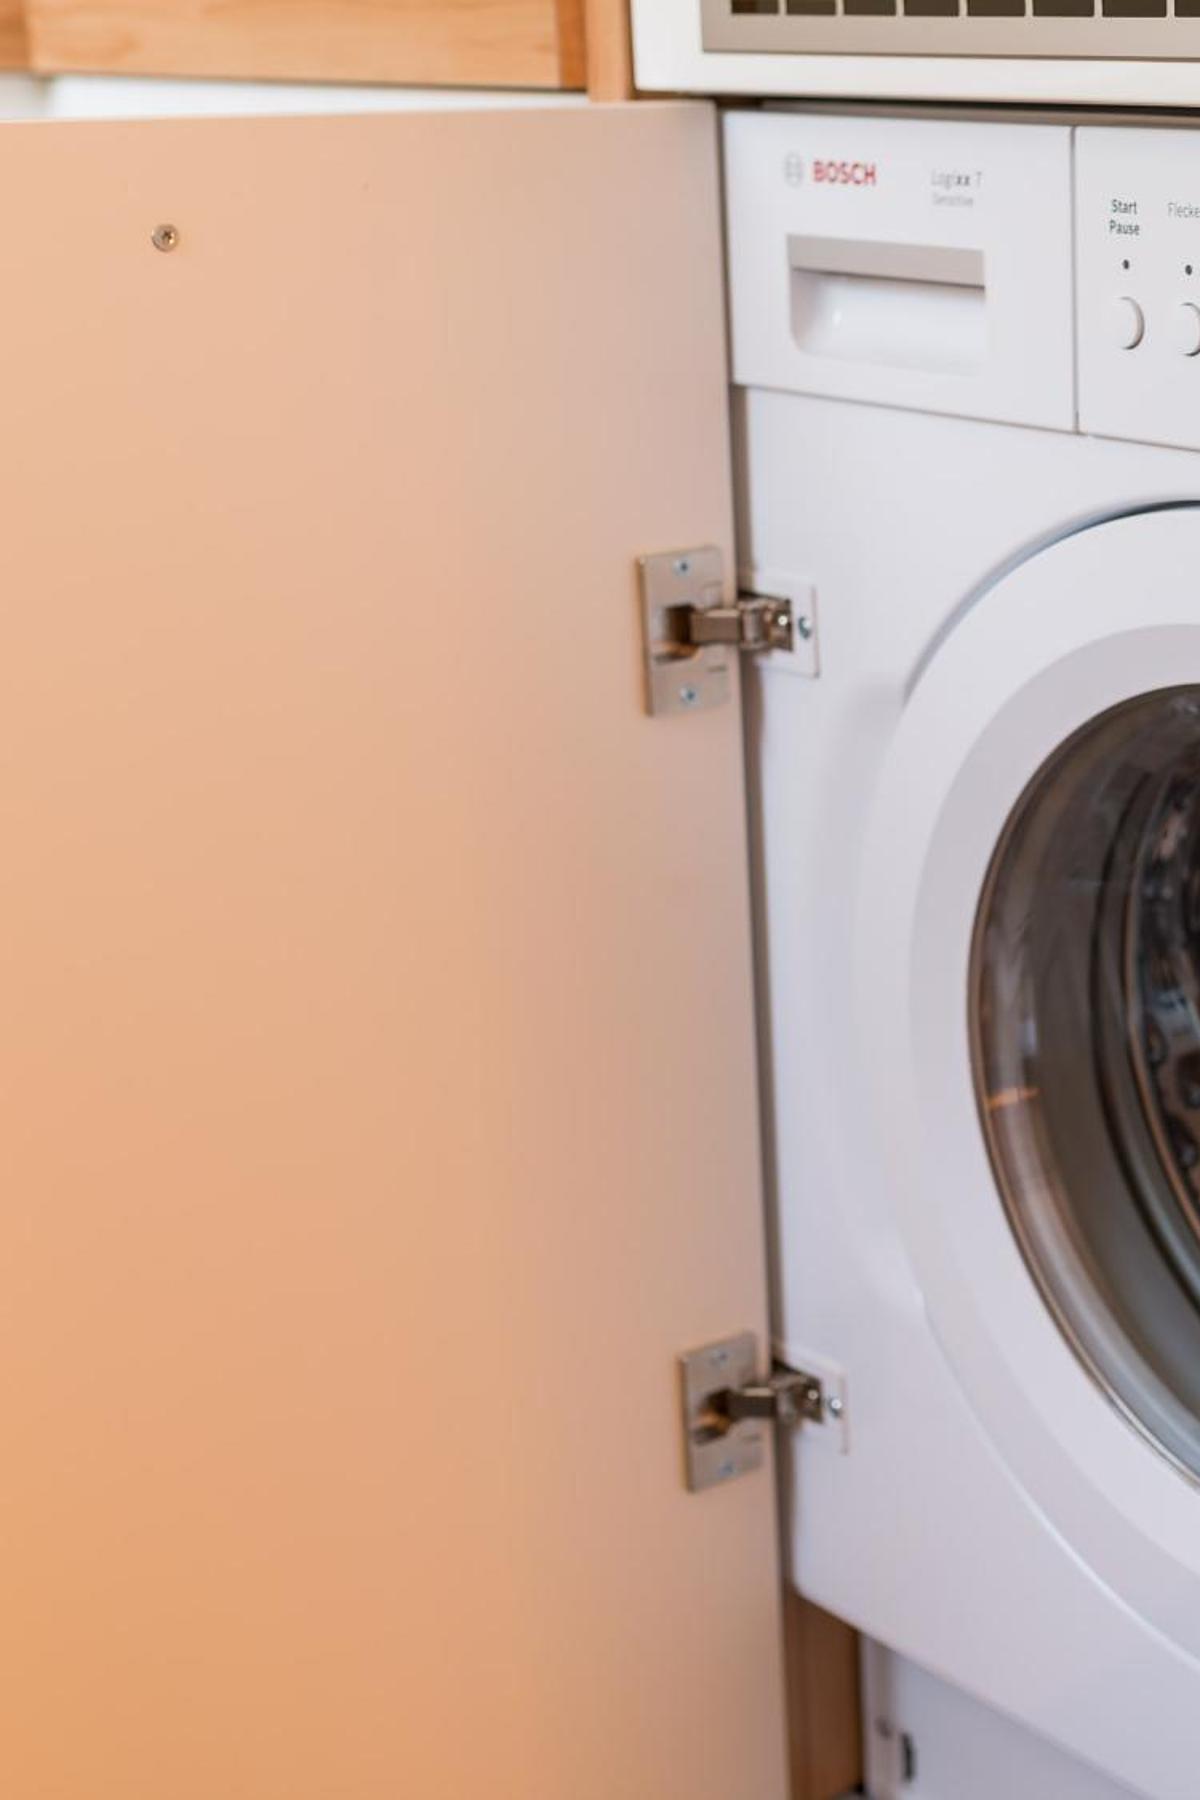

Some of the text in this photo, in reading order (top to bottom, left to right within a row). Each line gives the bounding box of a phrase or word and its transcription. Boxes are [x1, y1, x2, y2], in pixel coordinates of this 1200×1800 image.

[813, 160, 877, 186] BOSCH
[1111, 198, 1138, 215] Start
[1109, 219, 1141, 237] Pause
